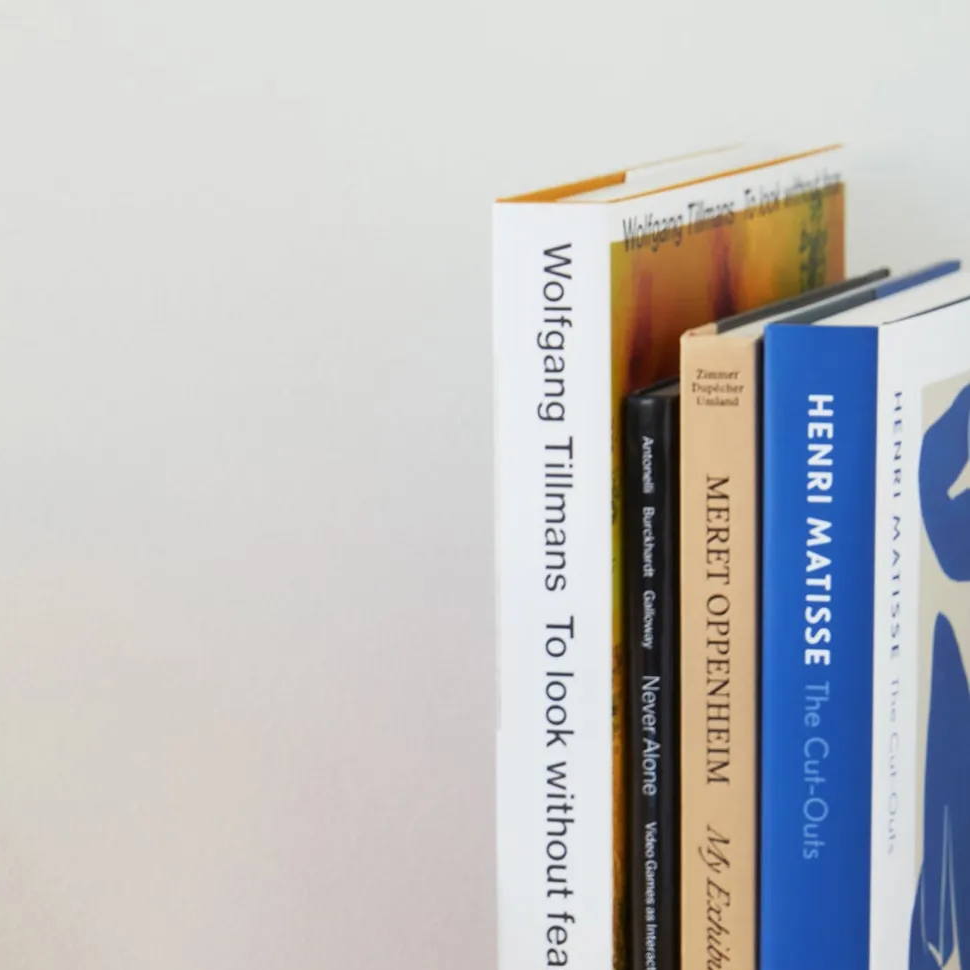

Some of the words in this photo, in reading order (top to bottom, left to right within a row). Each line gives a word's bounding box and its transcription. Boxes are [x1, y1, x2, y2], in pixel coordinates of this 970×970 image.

[537, 243, 573, 422] Wolfgang
[642, 436, 654, 494] Antonelli
[807, 394, 834, 504] HENRI
[893, 391, 902, 498] HENRI
[544, 437, 574, 592] Tillmans
[642, 506, 655, 578] Burckhardt
[706, 474, 730, 585] MERET
[642, 590, 656, 650] Galloway
[804, 518, 833, 666] MATISSE
[890, 515, 902, 658] MATISSE
[545, 615, 574, 658] To
[546, 672, 575, 748] look
[642, 675, 660, 731] Never
[706, 593, 730, 785] OPPENHEIM
[803, 682, 831, 727] The
[642, 736, 660, 796] Alone
[802, 737, 830, 860] Cut-Outs
[546, 761, 576, 899] without
[644, 821, 658, 858] Video
[698, 824, 731, 875] My
[644, 860, 658, 904] Games
[645, 907, 655, 922] as
